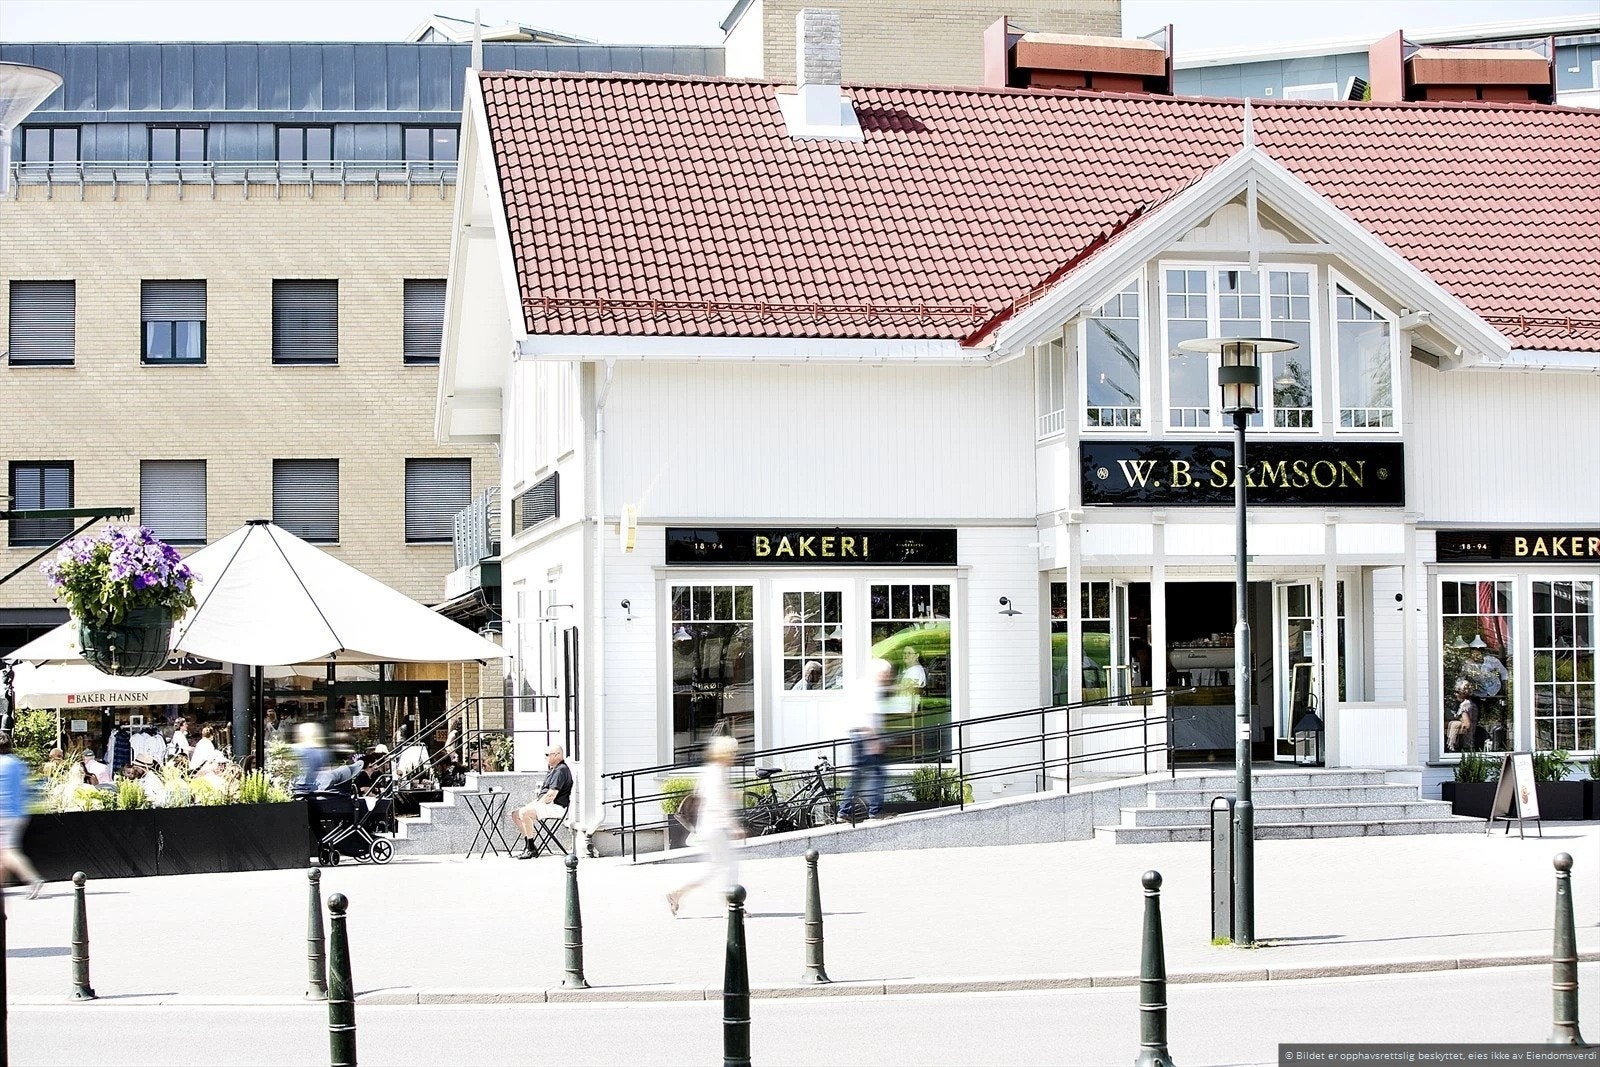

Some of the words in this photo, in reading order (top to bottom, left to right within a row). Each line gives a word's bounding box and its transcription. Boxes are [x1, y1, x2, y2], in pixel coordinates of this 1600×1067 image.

[1117, 460, 1159, 488] W.
[1170, 460, 1199, 488] B.
[755, 536, 868, 556] BAKERI
[76, 693, 106, 704] BAKER
[109, 692, 149, 702] HANSEN
